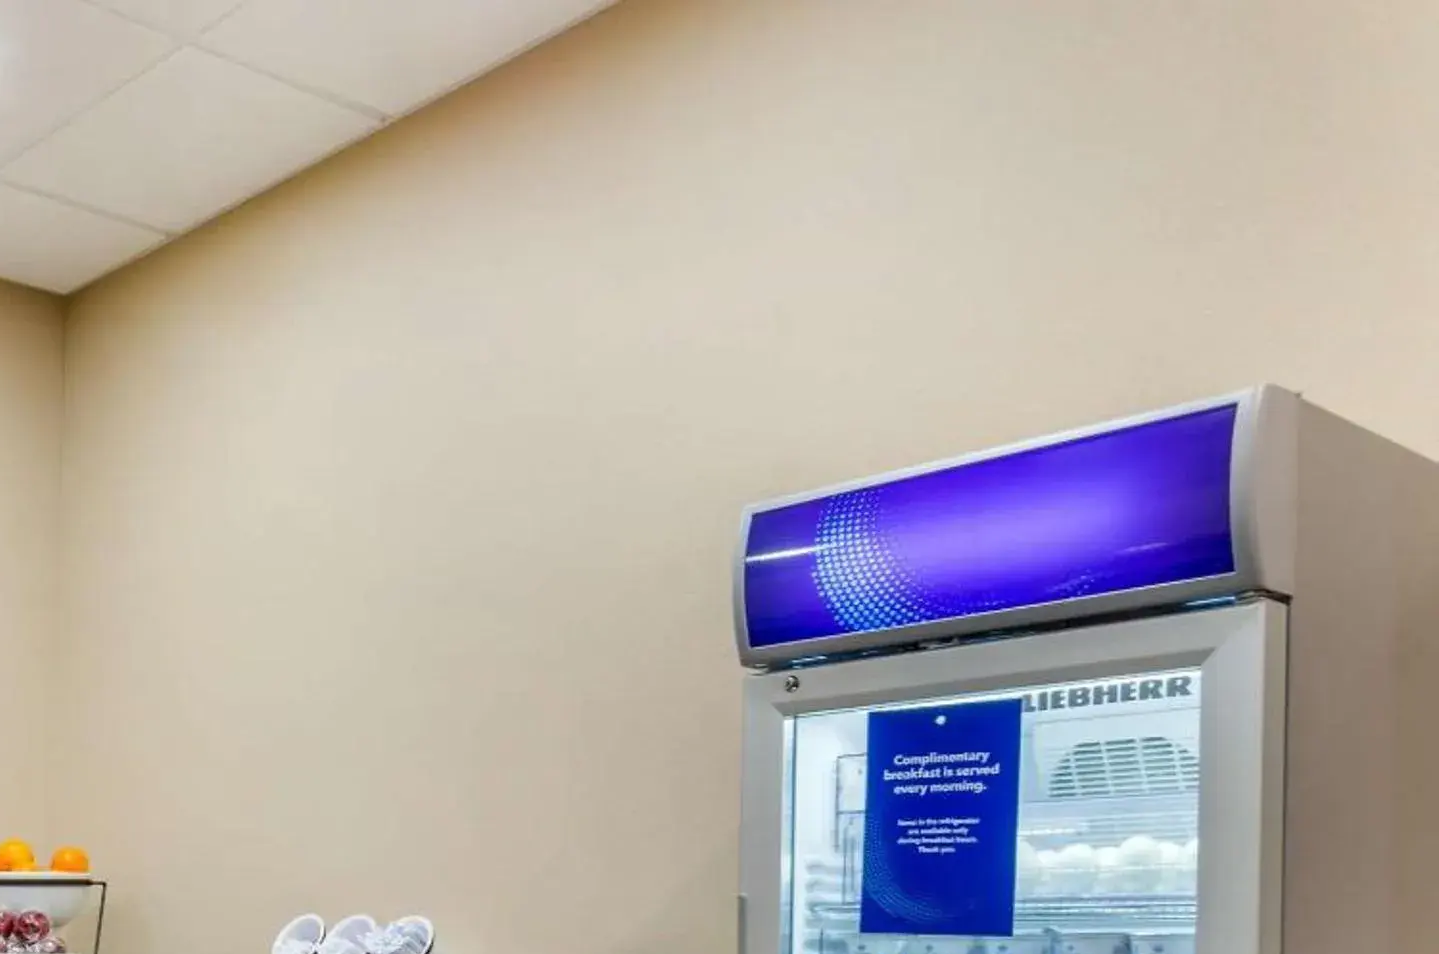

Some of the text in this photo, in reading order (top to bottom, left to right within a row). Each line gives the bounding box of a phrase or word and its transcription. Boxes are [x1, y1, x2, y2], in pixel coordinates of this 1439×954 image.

[1022, 675, 1192, 713] LIEBHERR
[893, 751, 991, 767] Complimentary
[883, 762, 1001, 781] breakfast is served
[893, 780, 988, 796] every morning.
